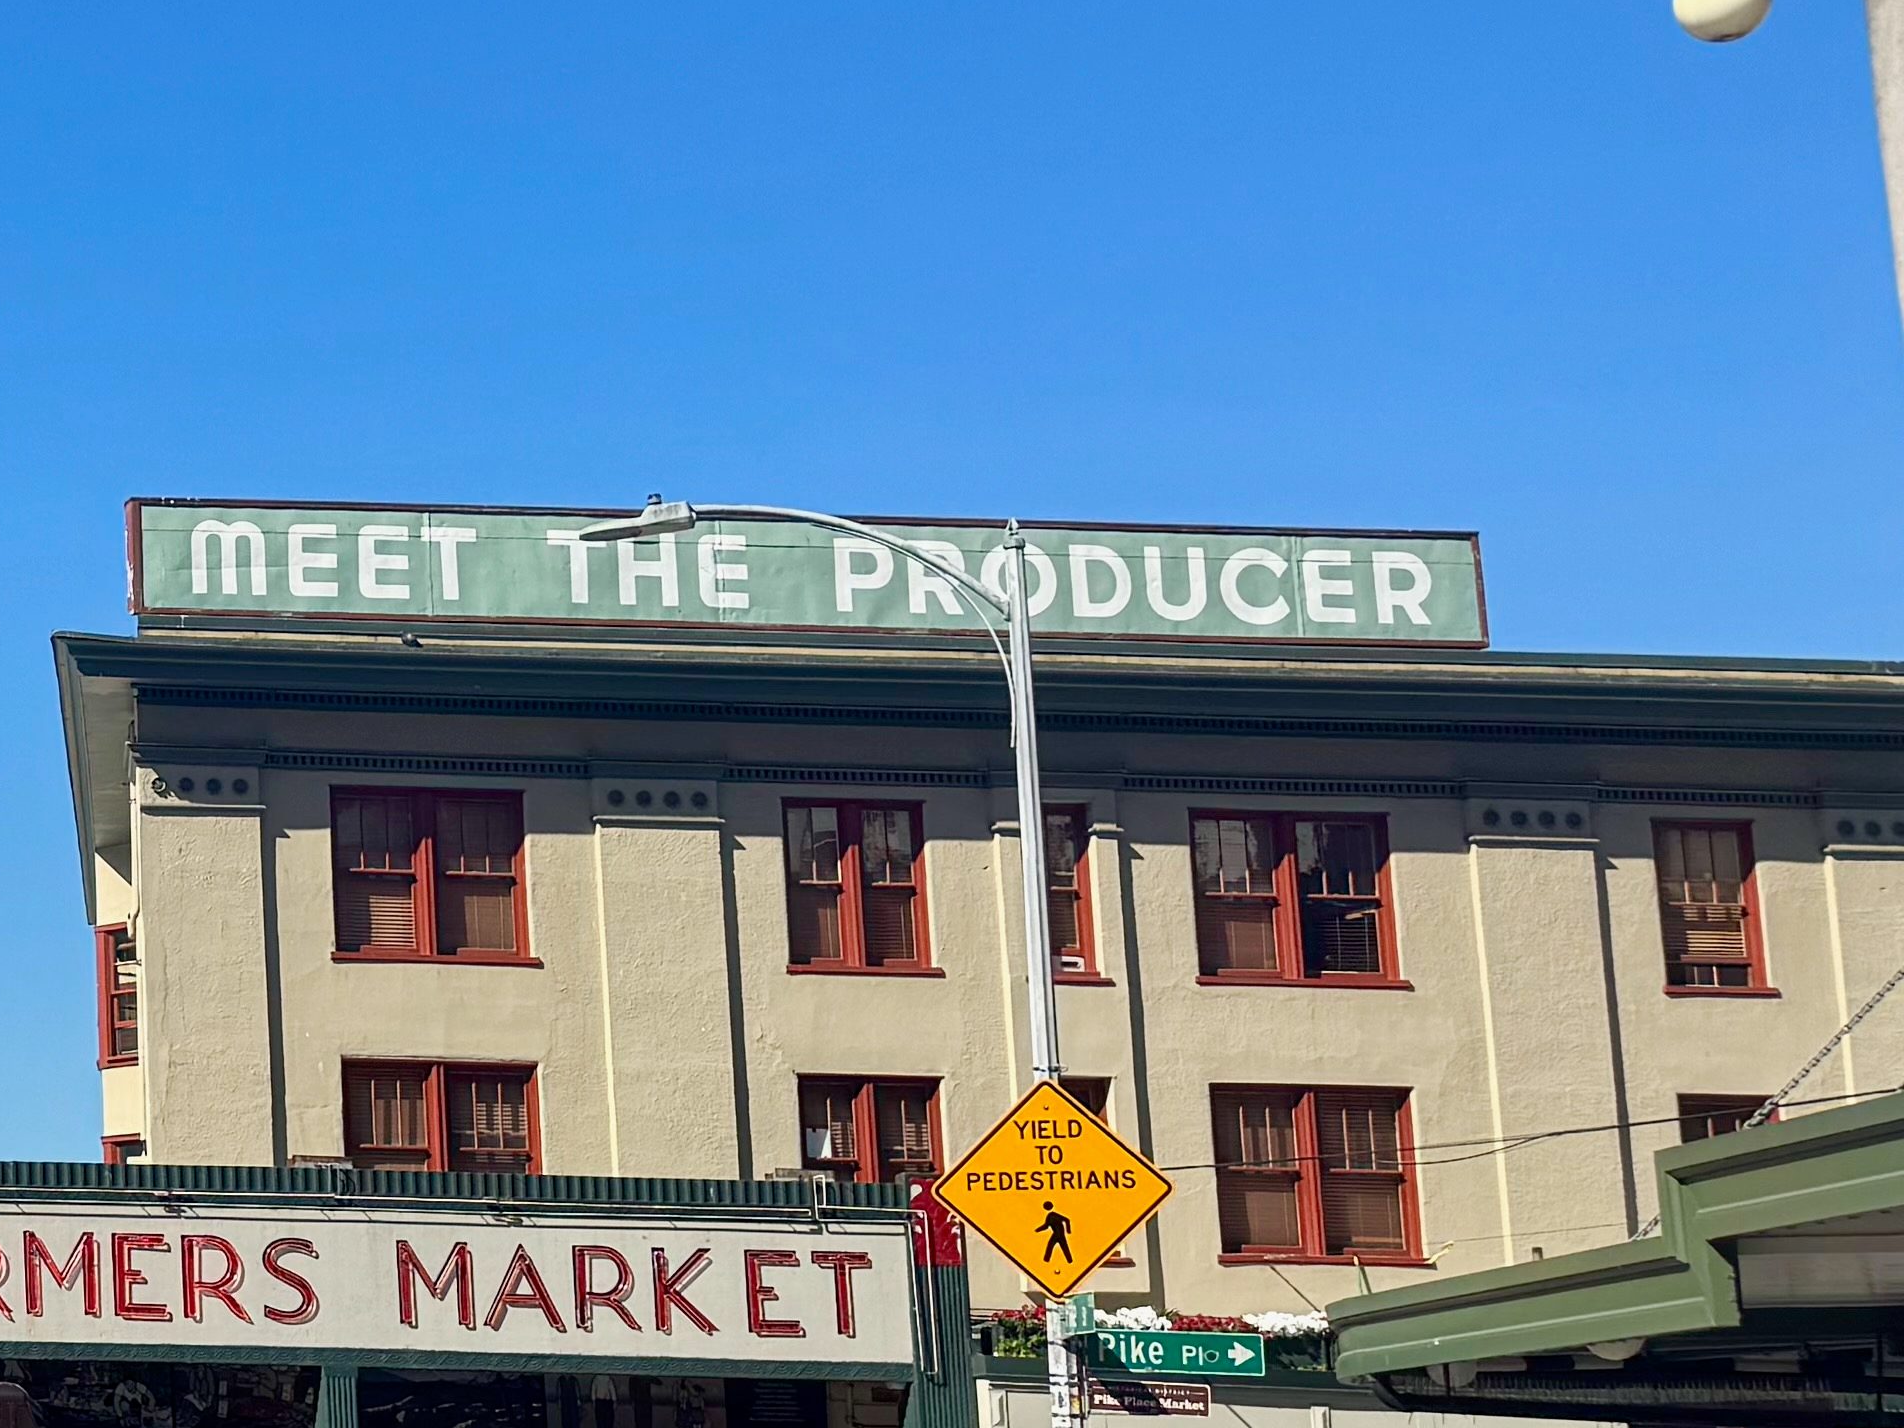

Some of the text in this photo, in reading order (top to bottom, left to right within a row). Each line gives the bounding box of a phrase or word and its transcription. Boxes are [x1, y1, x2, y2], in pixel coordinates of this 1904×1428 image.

[190, 516, 1435, 626] MEET THE PRODUCER
[1012, 1119, 1083, 1140] YIELD
[1034, 1144, 1064, 1165] TO
[966, 1169, 1137, 1192] PEDESTRIANS
[396, 1238, 874, 1339] MARKET
[1097, 1332, 1165, 1366] Pike
[1093, 1393, 1206, 1412] Pike Place Market
